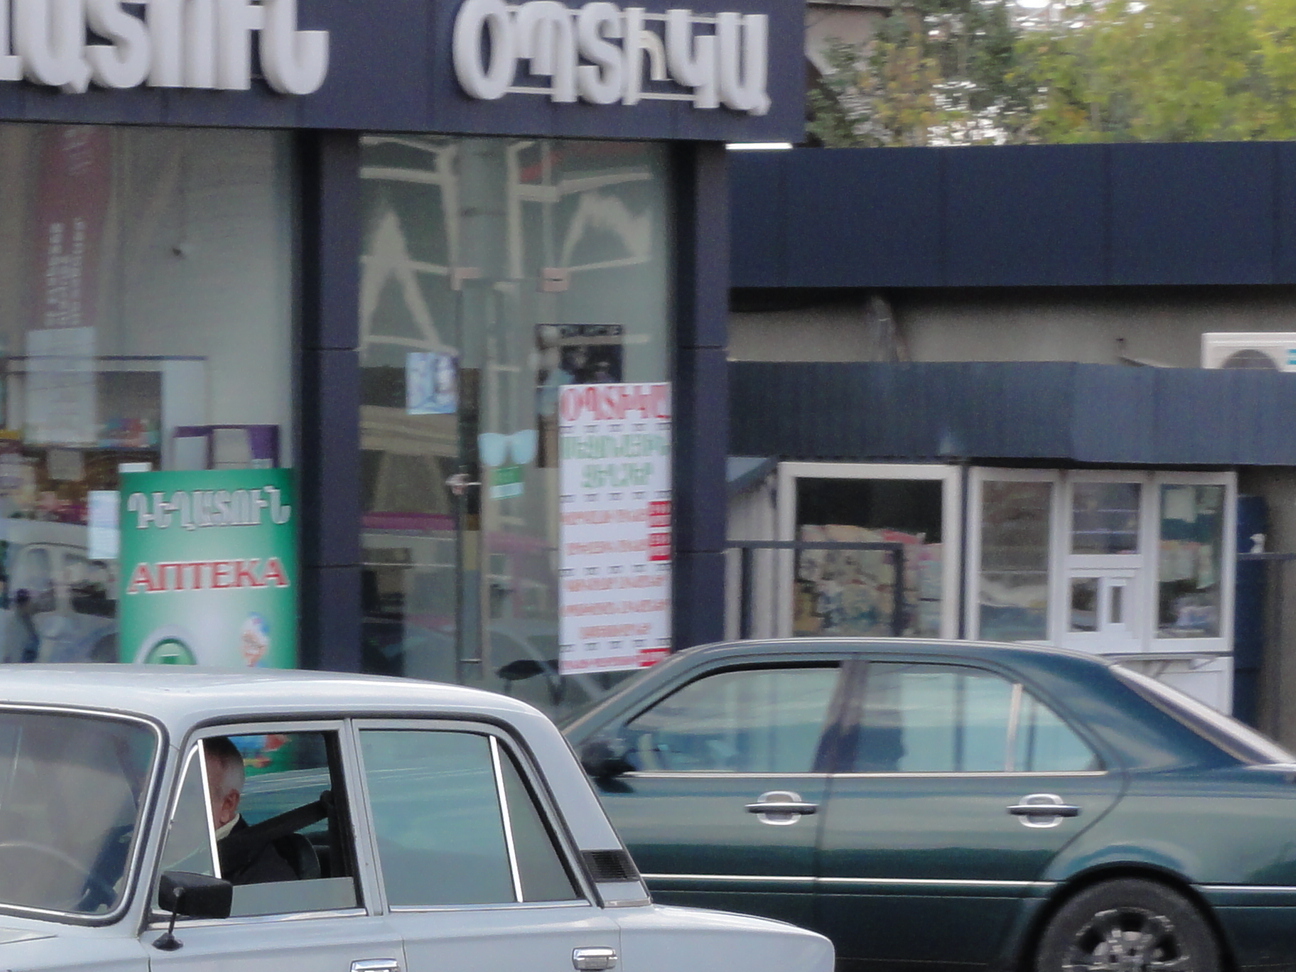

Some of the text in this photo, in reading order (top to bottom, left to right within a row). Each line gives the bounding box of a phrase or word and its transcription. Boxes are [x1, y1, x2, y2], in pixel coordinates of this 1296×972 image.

[453, 0, 772, 116] ՕՊՏԻԿԱ
[126, 485, 292, 531] ԴԵՂԱՏՈՒՆ
[126, 557, 291, 594] АПТЕКА
